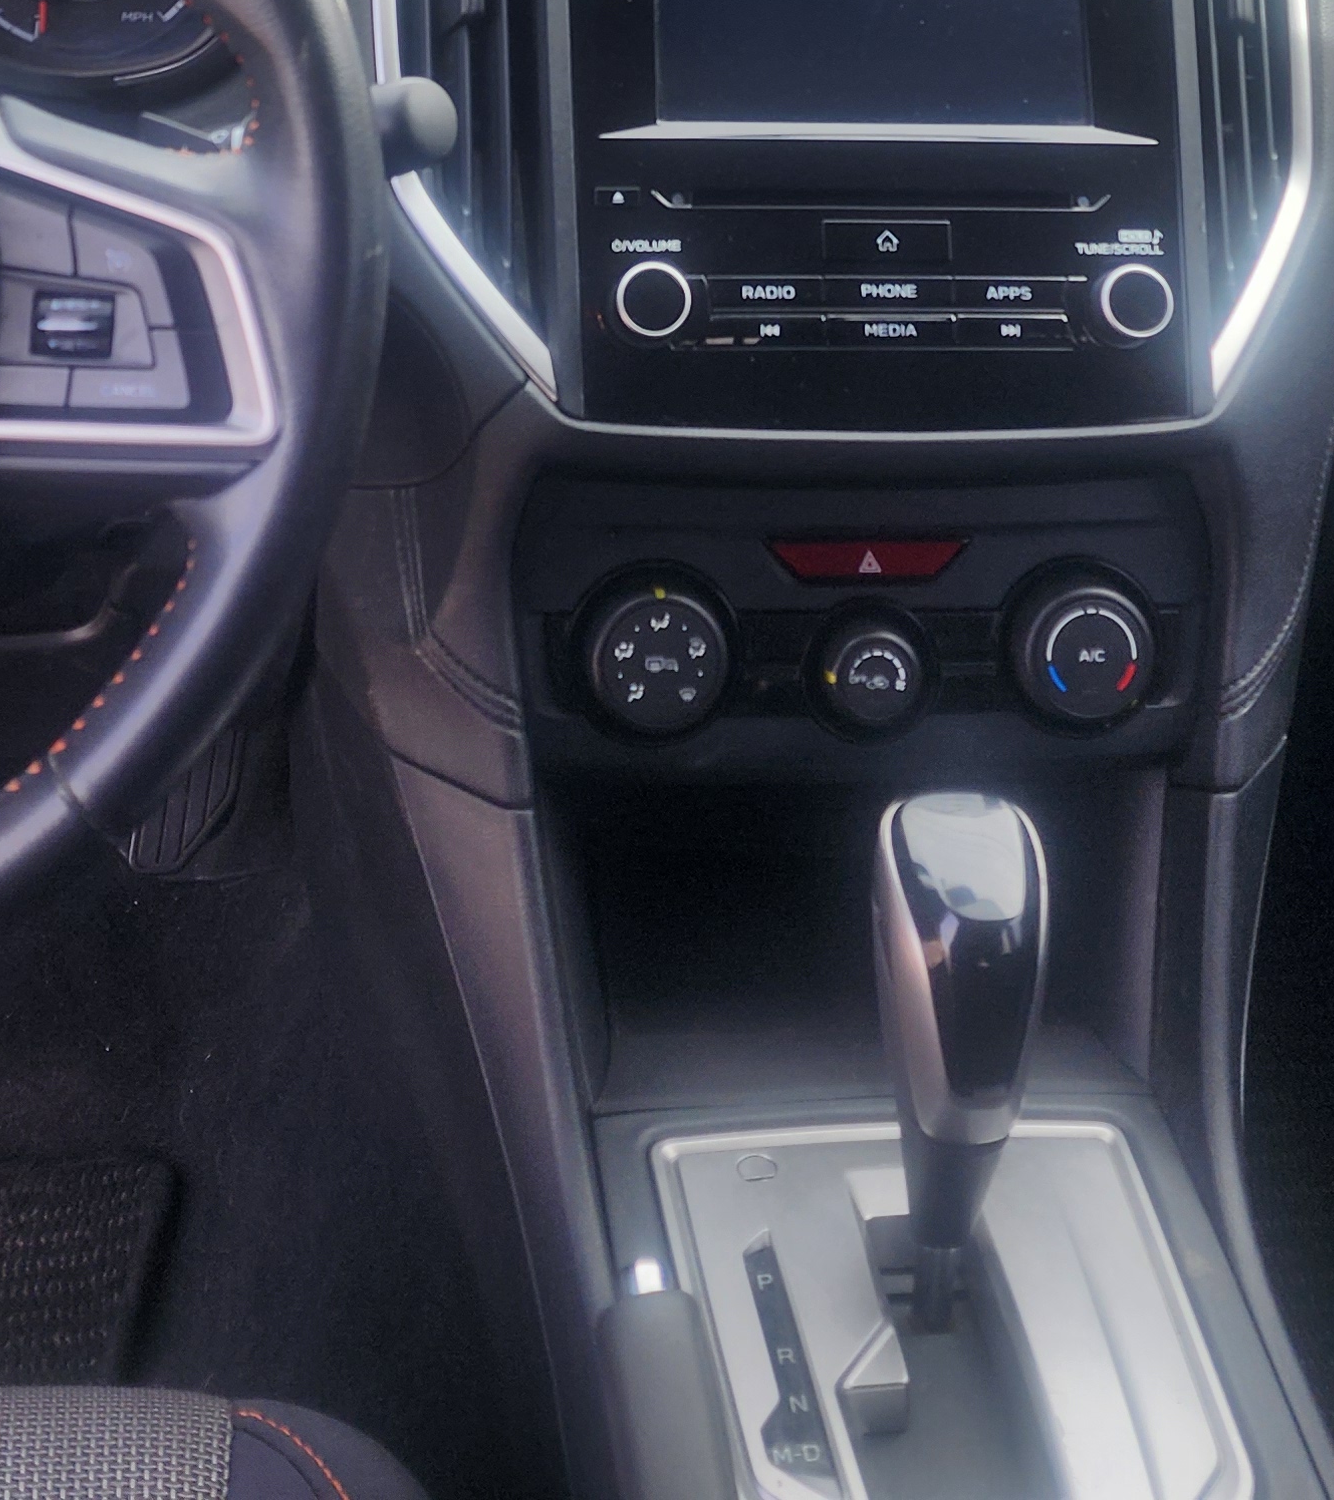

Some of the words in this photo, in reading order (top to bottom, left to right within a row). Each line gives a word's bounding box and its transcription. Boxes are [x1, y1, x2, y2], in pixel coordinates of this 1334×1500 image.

[121, 11, 154, 23] MPH
[741, 285, 796, 300] RADIO
[860, 283, 918, 298] PHONE
[985, 286, 1033, 301] APPS
[864, 323, 918, 338] MEDIA
[1078, 649, 1105, 663] A/C
[756, 1273, 774, 1290] P
[776, 1348, 797, 1365] R
[788, 1394, 809, 1414] N
